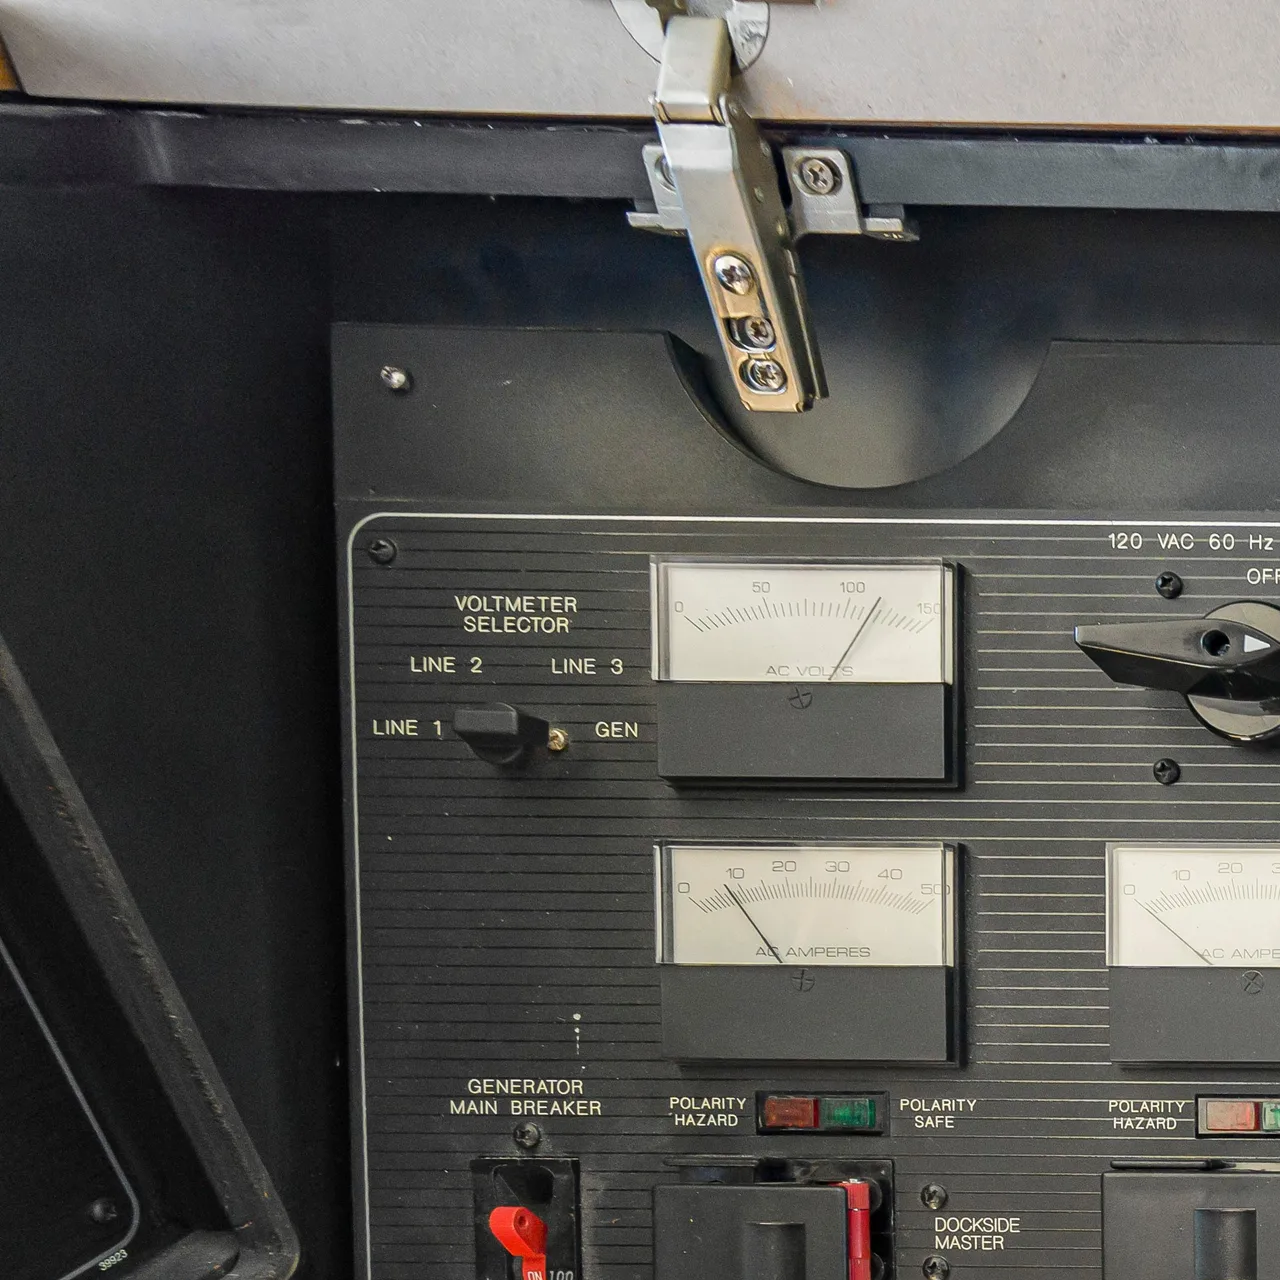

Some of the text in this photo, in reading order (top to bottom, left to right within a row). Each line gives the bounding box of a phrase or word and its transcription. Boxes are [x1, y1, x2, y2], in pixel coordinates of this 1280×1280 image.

[1108, 532, 1274, 551] 120 VAC 60 Hz
[753, 582, 770, 593] 50
[840, 582, 865, 593] 100
[454, 595, 578, 613] VOLTMETER
[463, 615, 569, 634] SELECTOR
[410, 656, 483, 674] LINE 2
[765, 665, 854, 678] AC VOLTS
[595, 721, 638, 738] GEN
[1218, 863, 1243, 873] 20
[1200, 948, 1225, 960] AC
[450, 1099, 602, 1116] MAIN BREAKER
[934, 1216, 1021, 1233] DOCKSIDE
